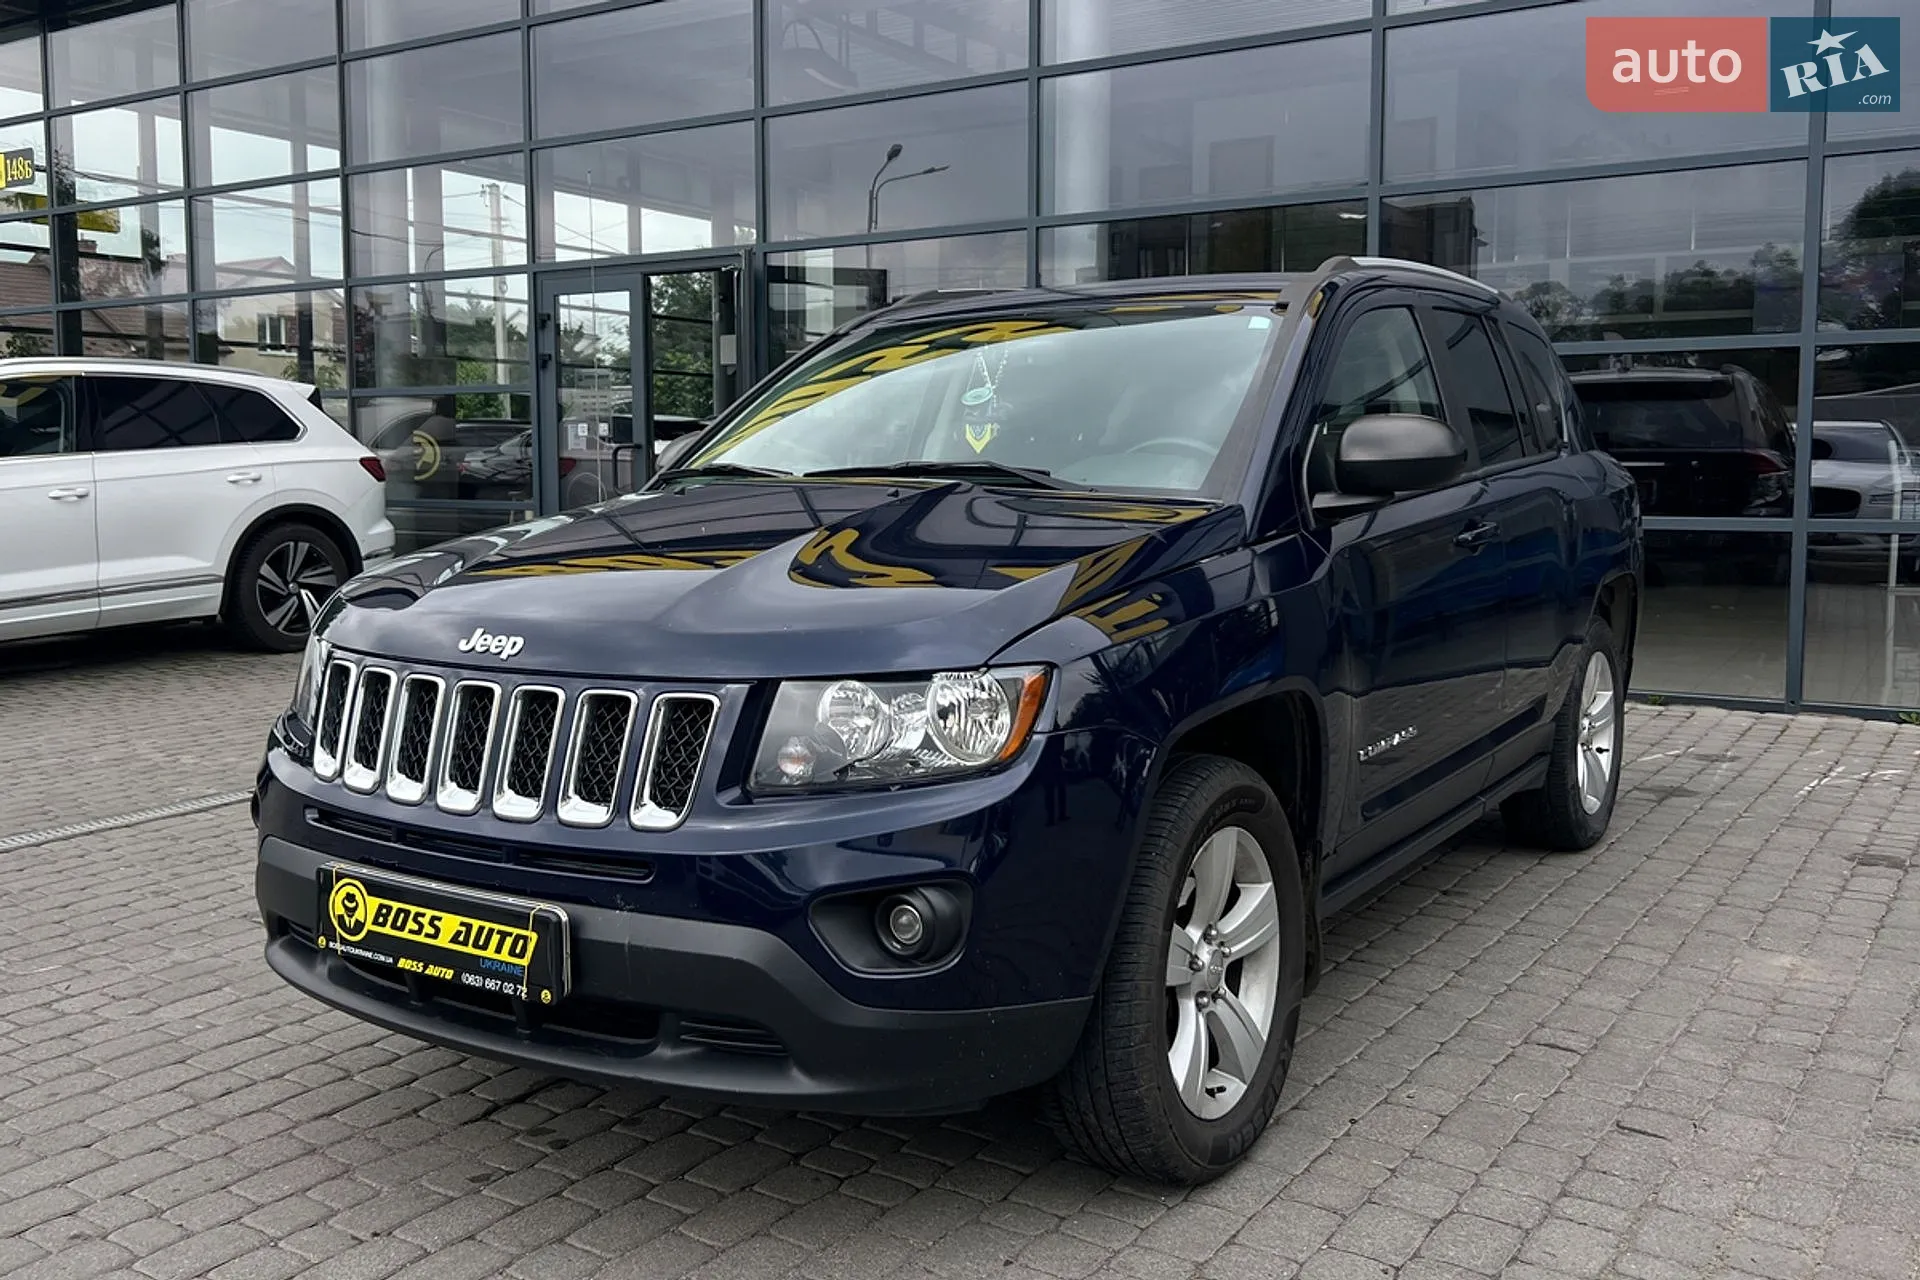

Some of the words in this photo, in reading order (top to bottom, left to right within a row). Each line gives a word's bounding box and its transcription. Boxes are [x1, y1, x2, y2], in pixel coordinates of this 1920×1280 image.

[458, 627, 525, 660] Jeep
[371, 902, 443, 939] BOSS
[448, 921, 530, 960] AUTO
[397, 957, 424, 973] BOSS
[424, 963, 455, 980] AUTO
[480, 957, 525, 976] UKRAINE
[484, 977, 502, 991] 667
[502, 982, 515, 995] 02
